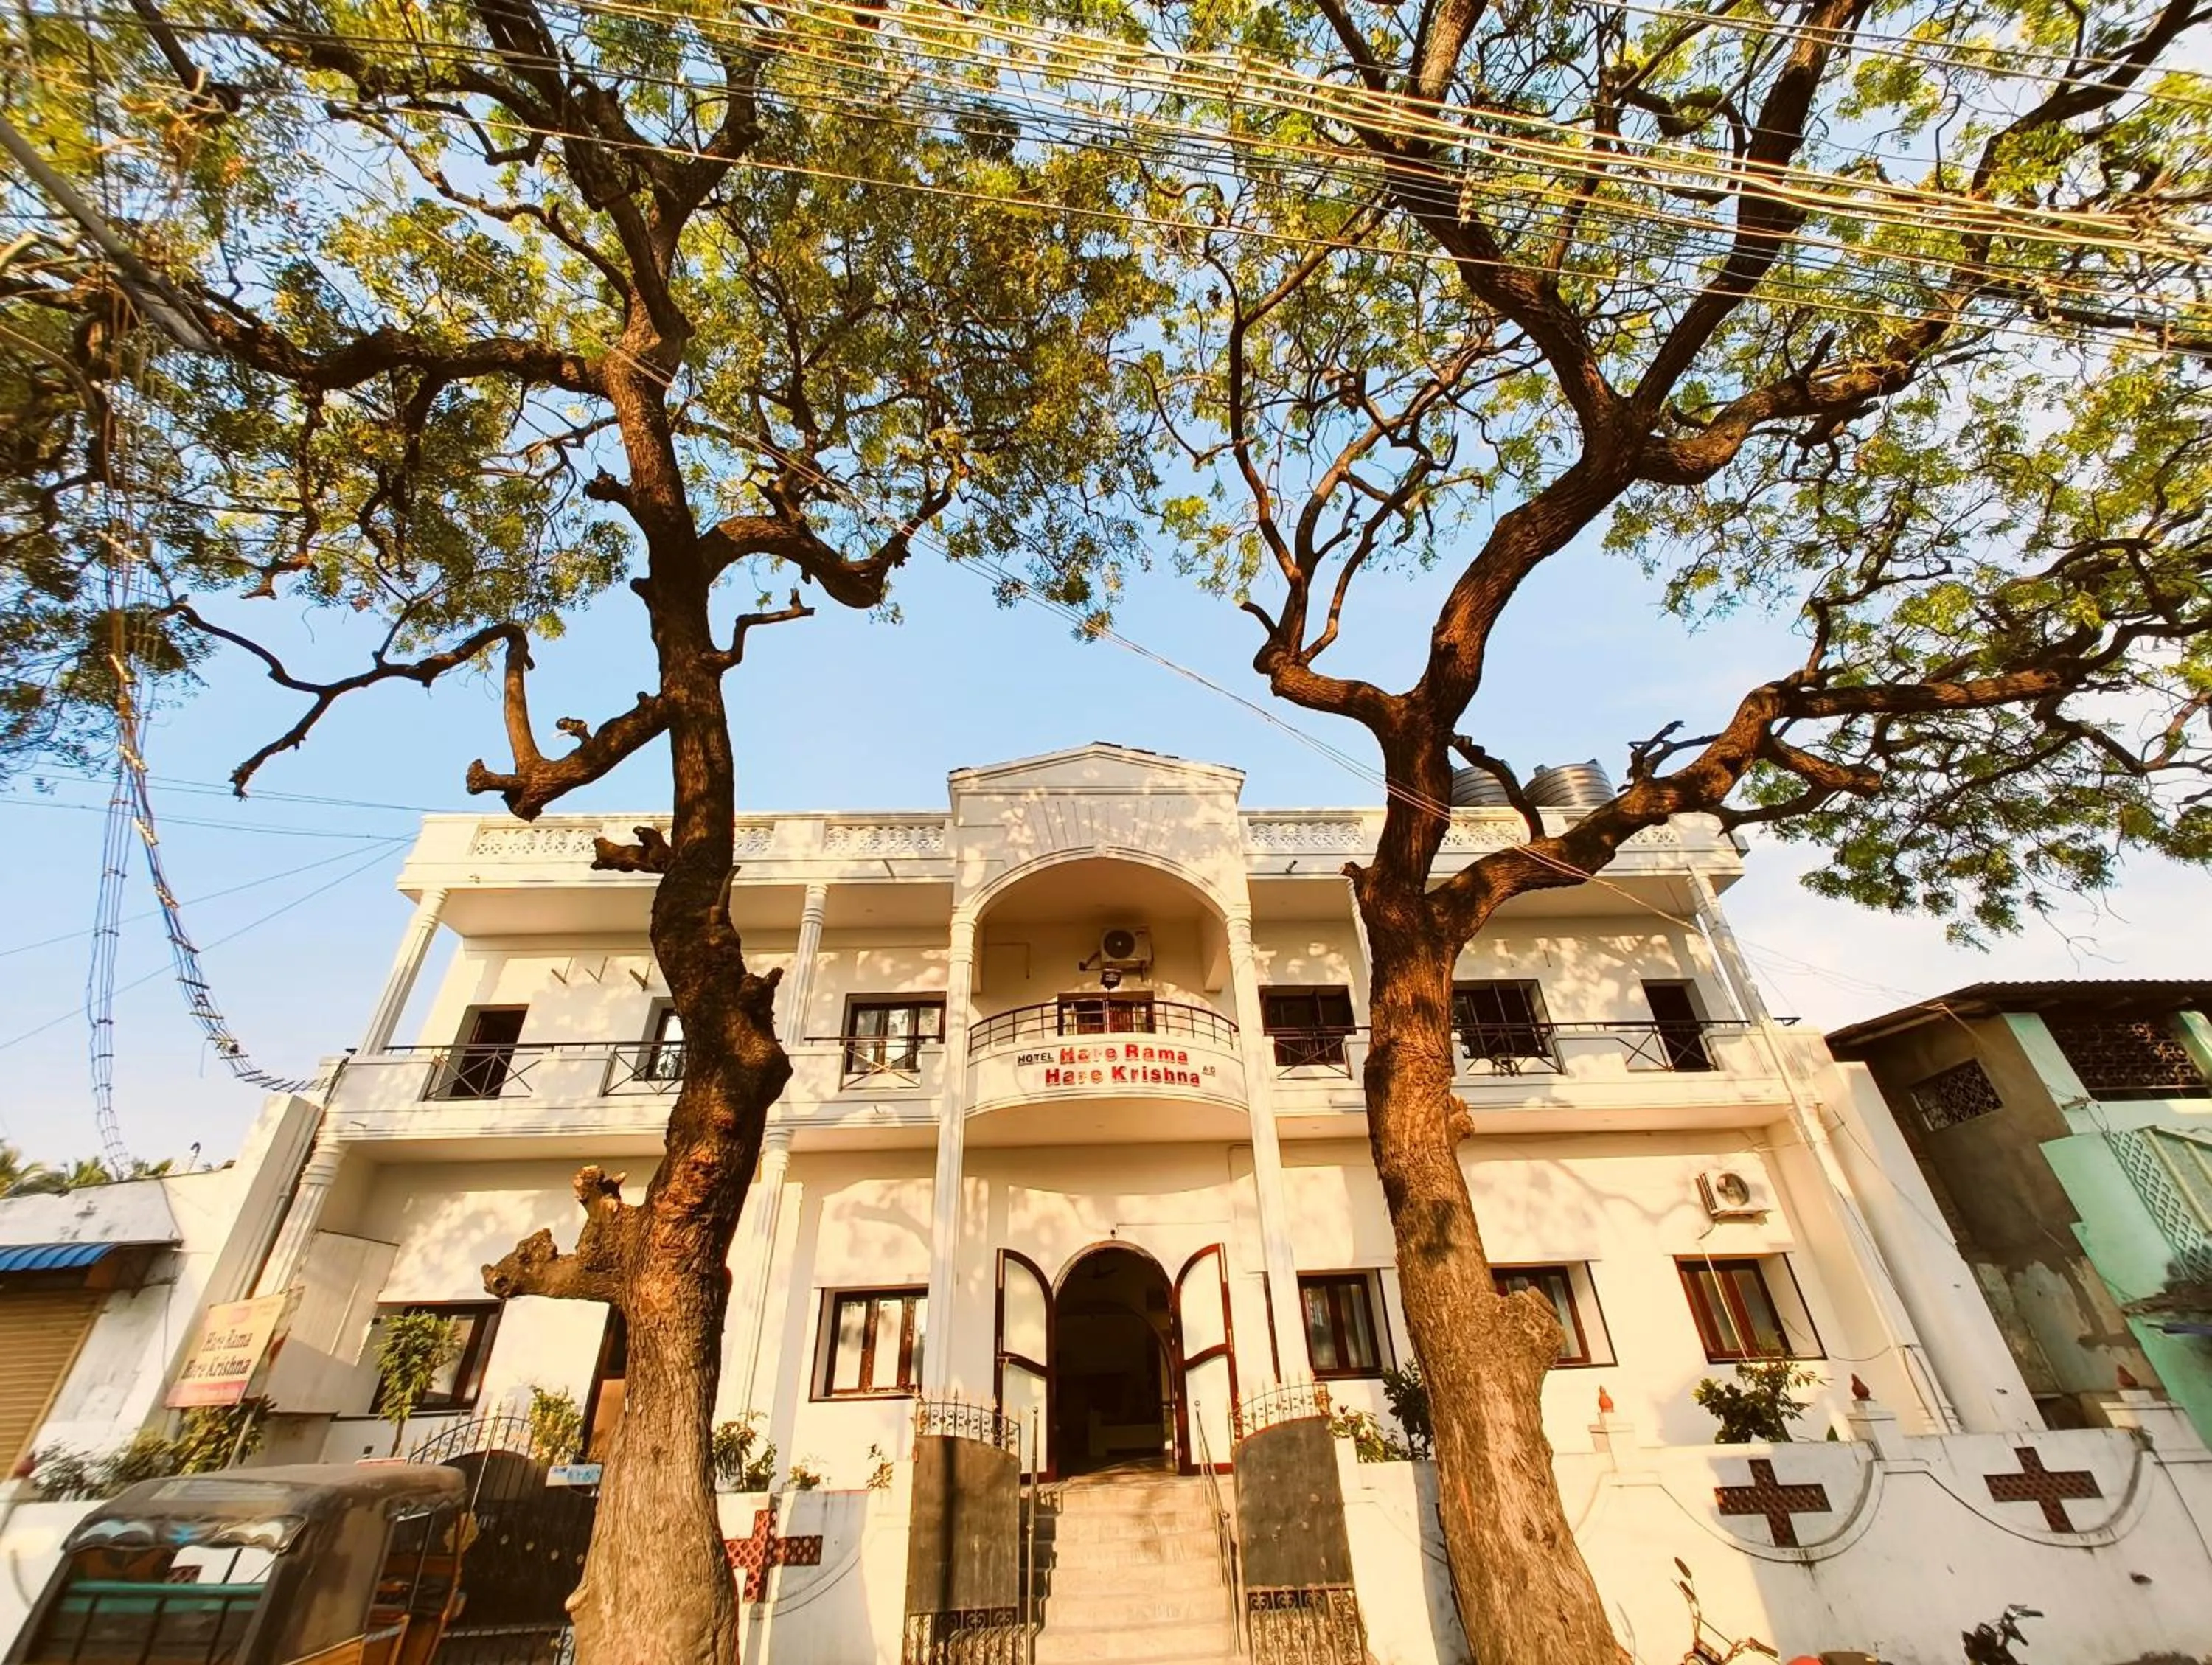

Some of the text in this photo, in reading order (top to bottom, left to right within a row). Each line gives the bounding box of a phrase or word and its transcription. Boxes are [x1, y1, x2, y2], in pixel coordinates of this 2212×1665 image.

[1017, 1043, 1189, 1066] HOTEL Hare Rama
[1045, 1068, 1104, 1086] Hare
[1111, 1066, 1200, 1087] Krishna
[205, 1355, 251, 1377] Krishna
